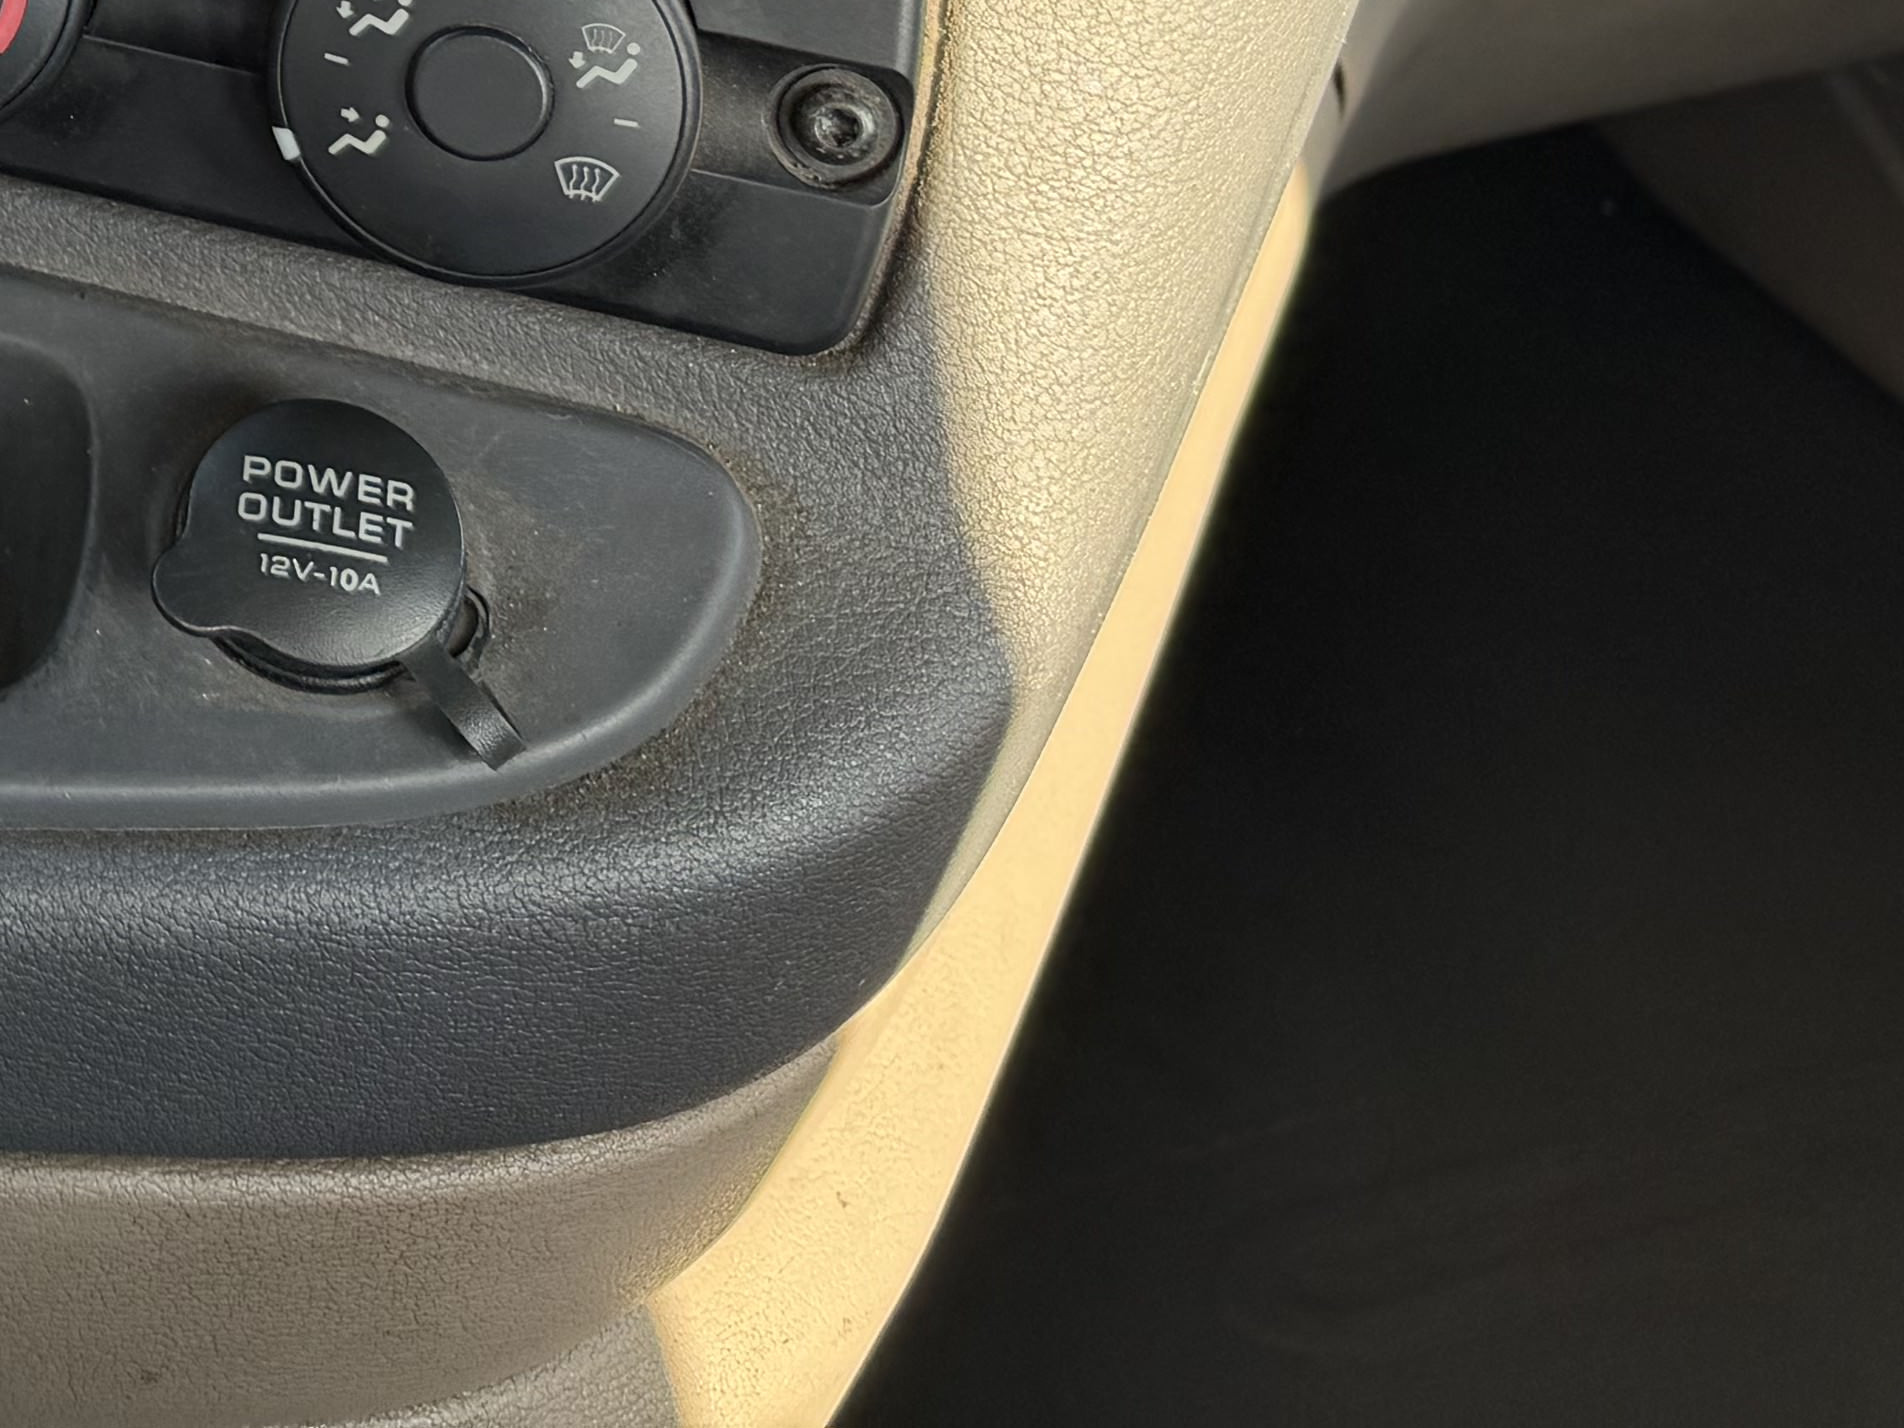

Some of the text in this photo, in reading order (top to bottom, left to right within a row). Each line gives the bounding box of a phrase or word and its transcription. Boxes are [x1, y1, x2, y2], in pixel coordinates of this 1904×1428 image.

[242, 454, 415, 511] POWER
[237, 491, 414, 548] OUTLET
[259, 553, 381, 596] 12V-10A
